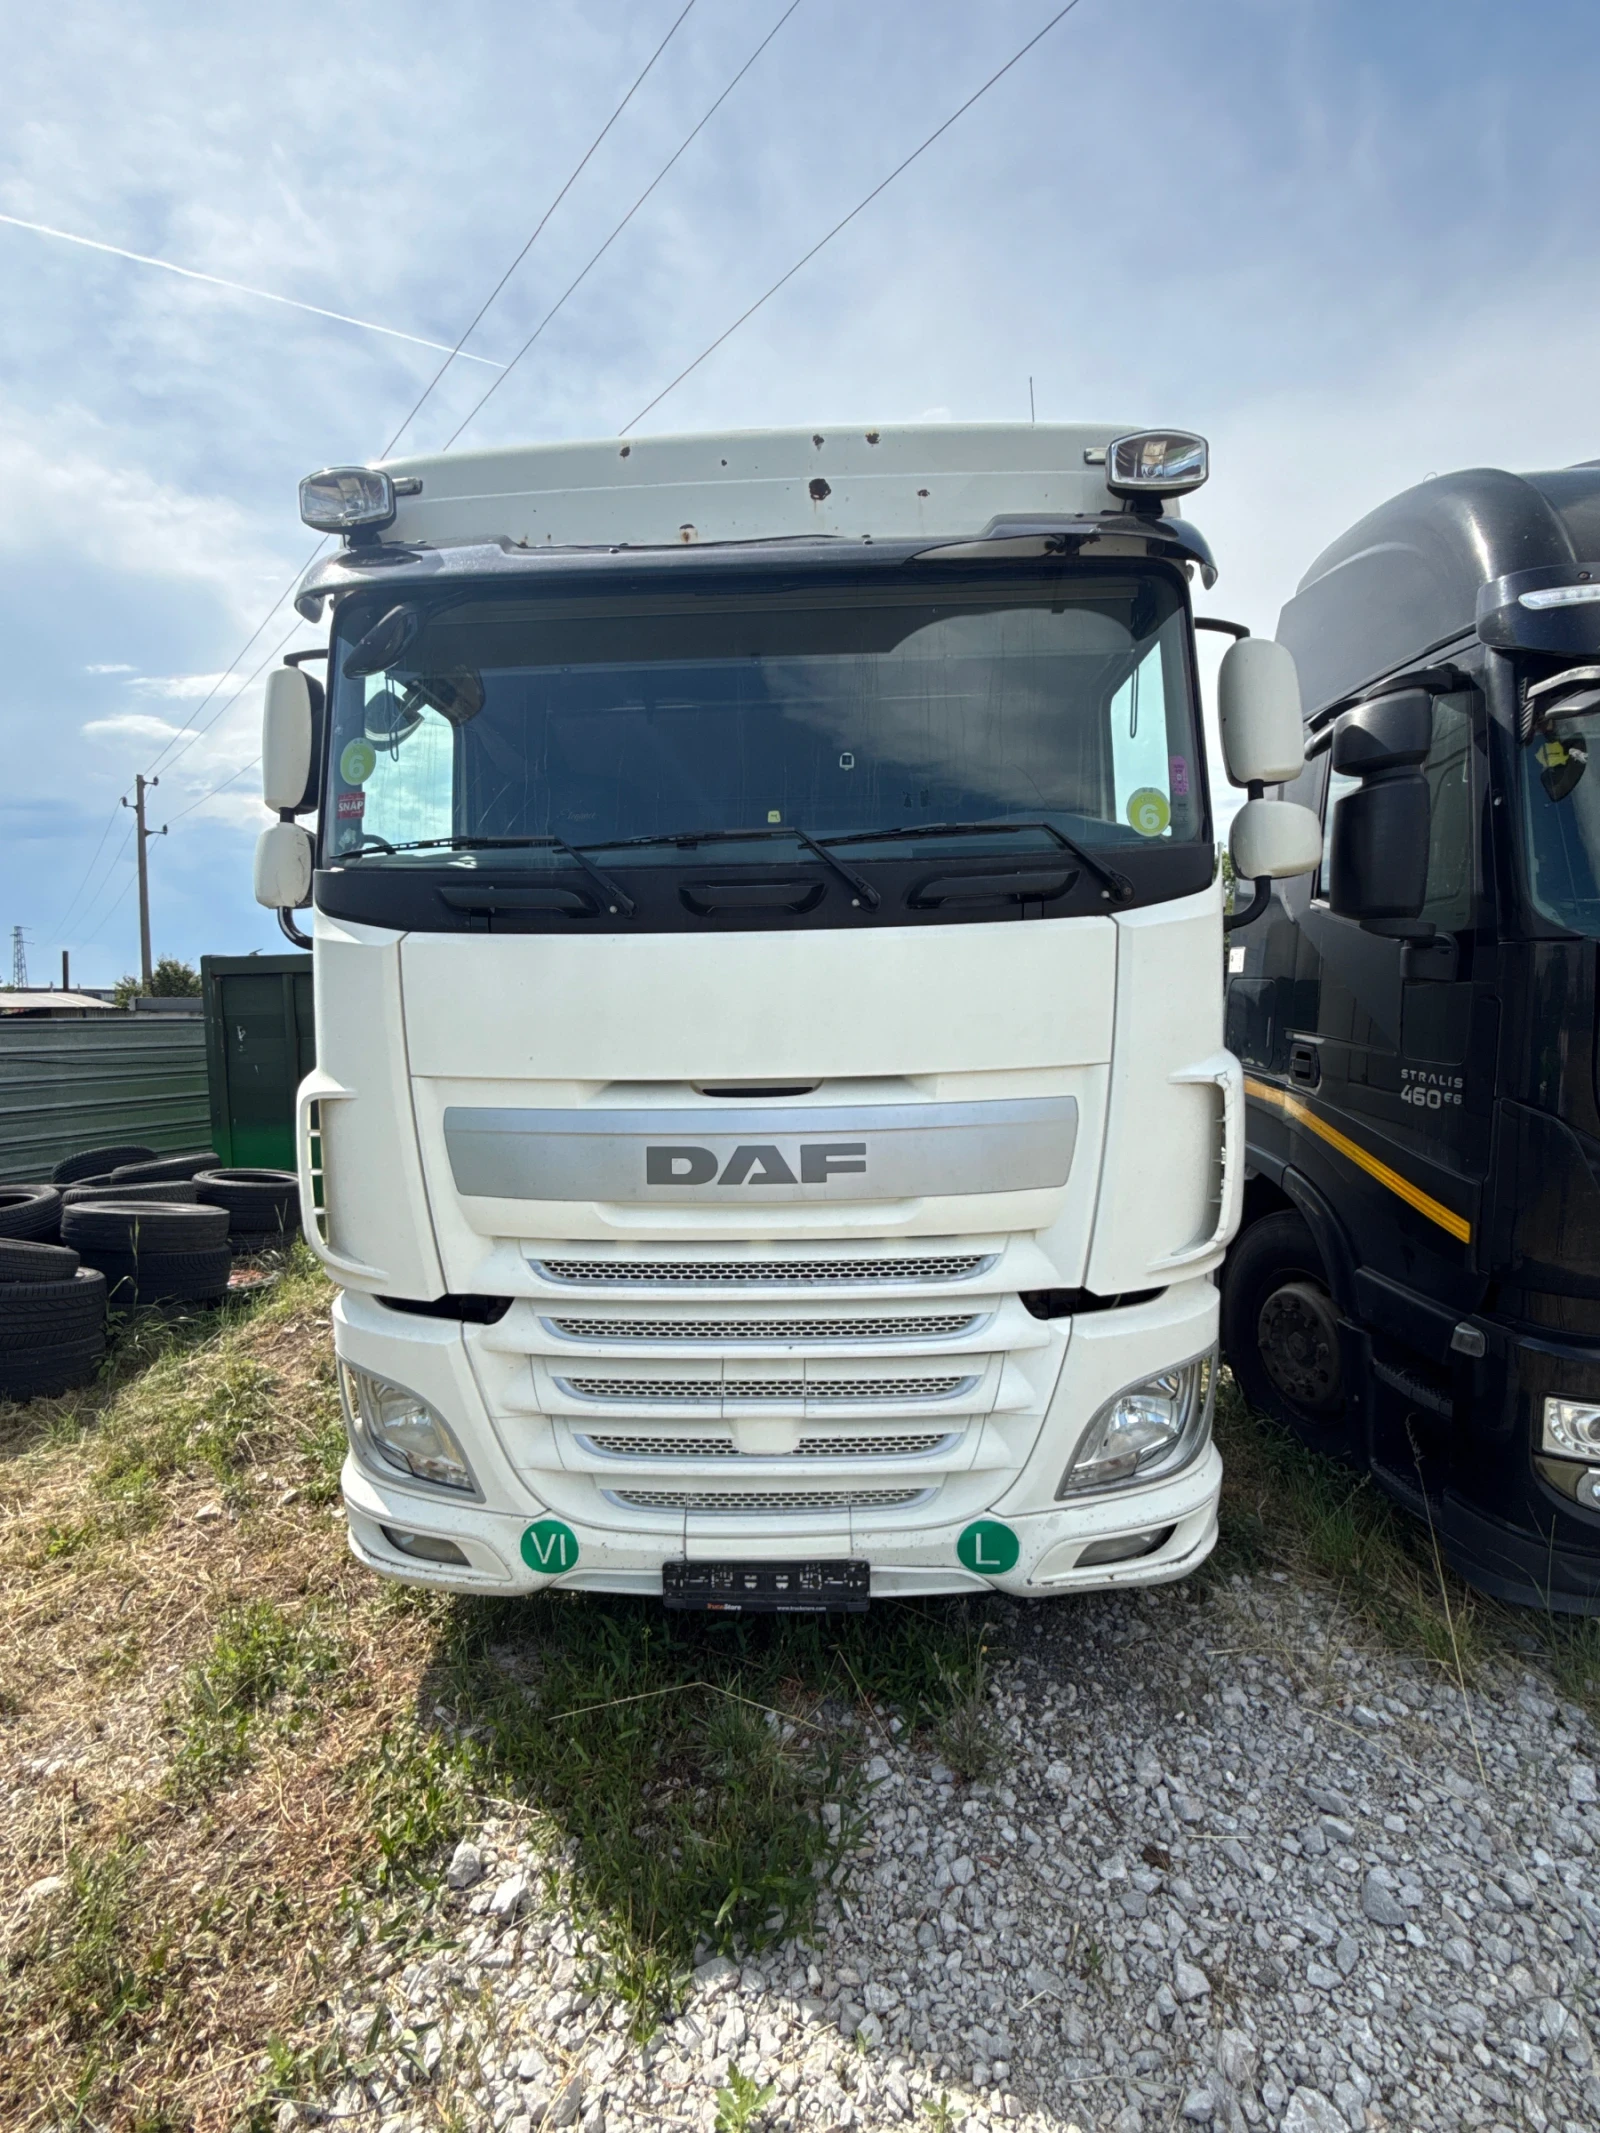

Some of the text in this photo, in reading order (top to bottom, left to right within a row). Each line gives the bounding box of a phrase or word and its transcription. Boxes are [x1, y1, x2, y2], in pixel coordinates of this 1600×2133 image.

[349, 755, 365, 778] 6
[338, 800, 364, 812] SNAP
[1139, 804, 1160, 829] 6
[1401, 1069, 1463, 1088] STRALIS
[1401, 1085, 1441, 1109] 460
[646, 1142, 867, 1185] DAF
[530, 1531, 566, 1566] VI
[975, 1532, 1001, 1565] L
